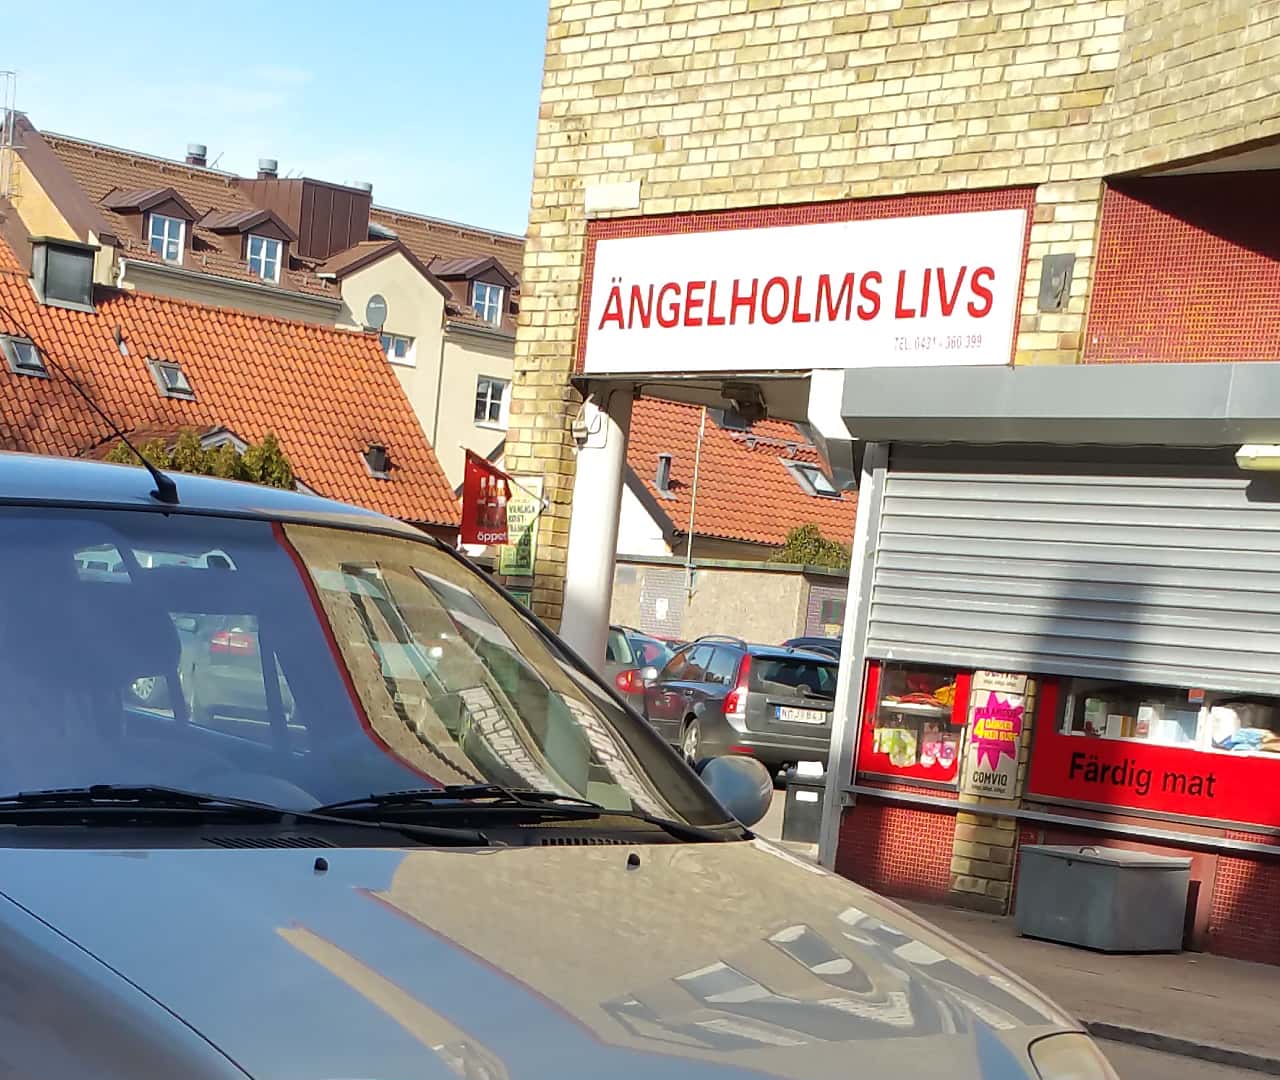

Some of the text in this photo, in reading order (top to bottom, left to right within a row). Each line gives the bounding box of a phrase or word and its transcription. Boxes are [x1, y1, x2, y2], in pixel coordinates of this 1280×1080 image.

[598, 266, 996, 330] ÄNGELHOLMS LIVS
[972, 771, 1008, 786] COMVIQ
[1068, 752, 1216, 798] Färdig mat
